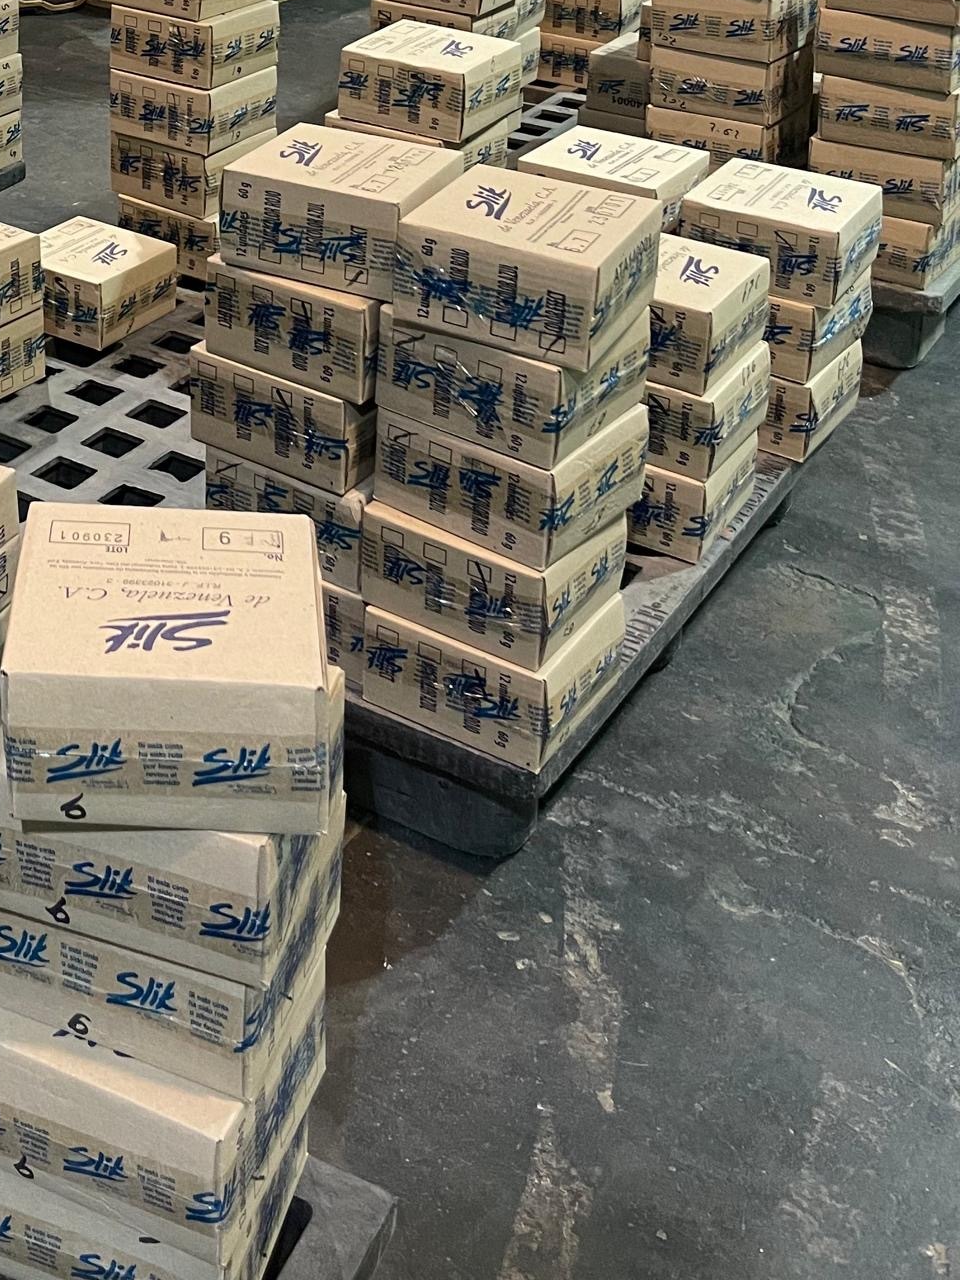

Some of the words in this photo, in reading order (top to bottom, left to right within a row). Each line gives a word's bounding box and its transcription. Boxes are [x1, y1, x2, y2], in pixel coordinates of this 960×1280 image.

[669, 13, 699, 31] Slik
[726, 19, 756, 37] Slik
[835, 37, 868, 52] Slik
[895, 45, 929, 62] Slik
[733, 89, 764, 106] Slik
[280, 139, 323, 167] Slik
[239, 188, 249, 199] 60
[884, 178, 914, 194] Slik
[467, 185, 512, 220] Slik
[92, 242, 128, 266] Slik
[421, 245, 432, 256] 60
[680, 256, 720, 287] Slik
[61, 531, 124, 543] 230901
[105, 546, 128, 554] LOTE
[263, 553, 284, 562] No.
[58, 586, 109, 601] C.A.
[122, 586, 235, 608] Venezuela,
[245, 594, 271, 608] de
[99, 610, 231, 655] Slik
[46, 738, 128, 784] Slik
[192, 743, 271, 787] Slik
[64, 861, 138, 900] Slik
[200, 901, 272, 942] Slik
[106, 971, 178, 1016] Slik
[63, 1146, 129, 1182] Slik
[71, 1253, 139, 1280] Slik
